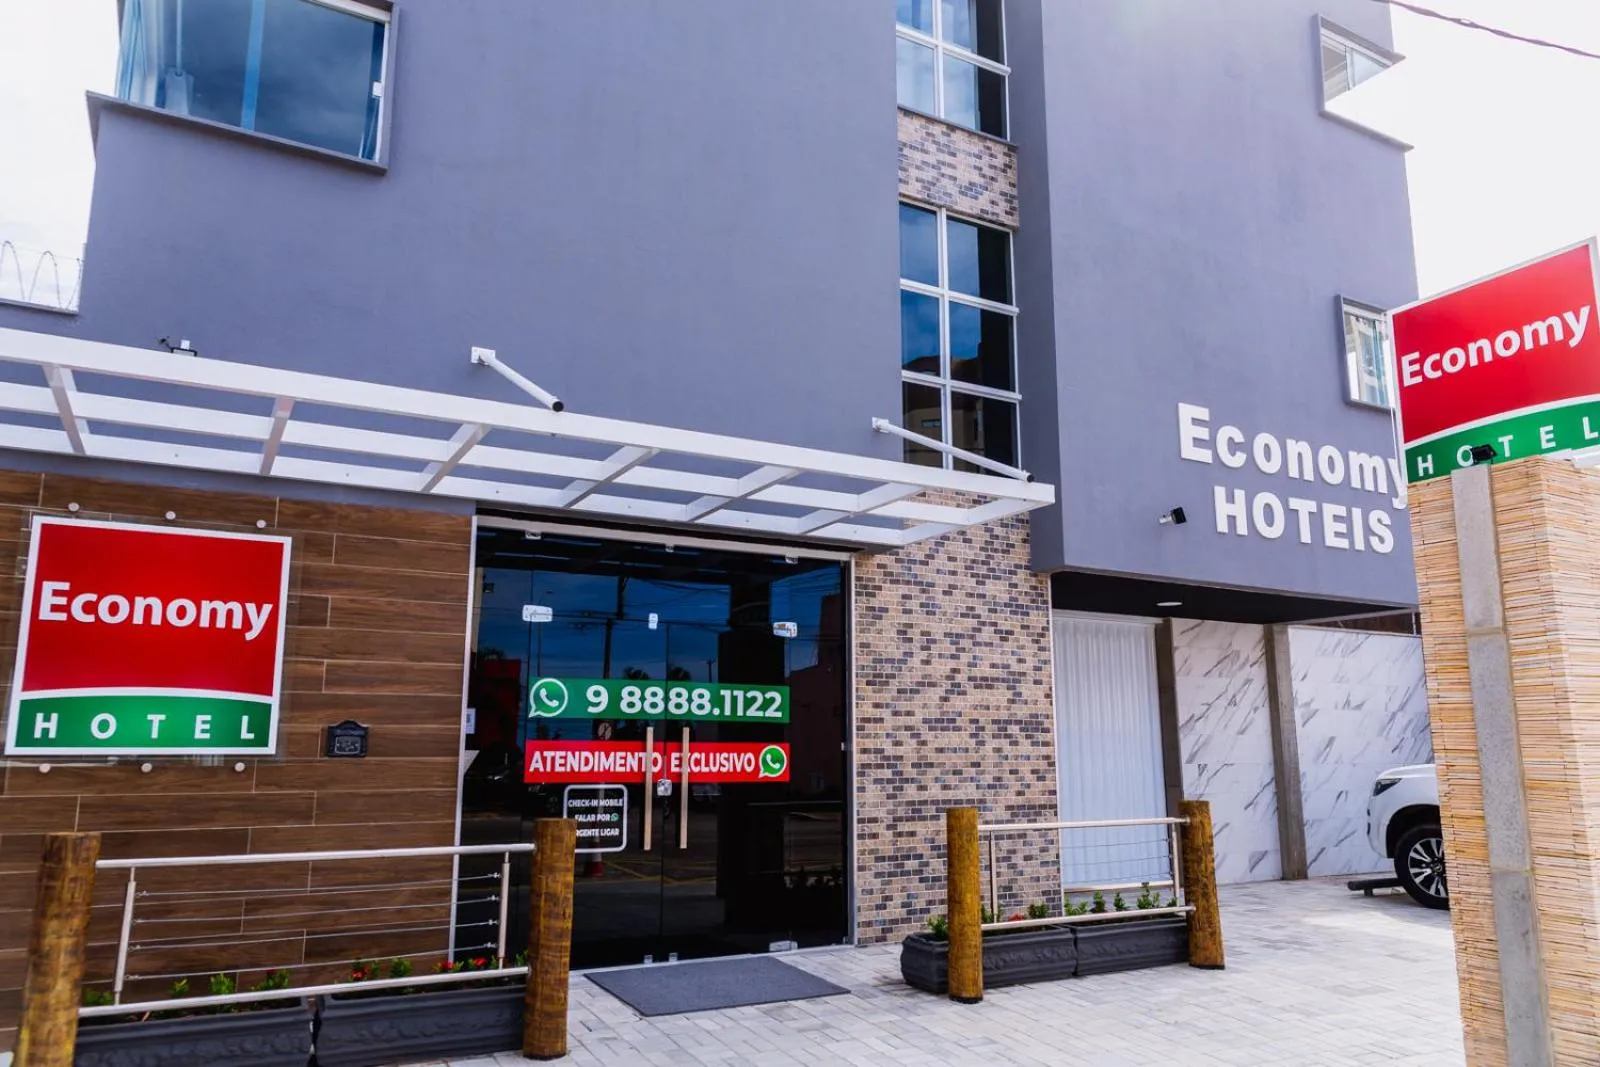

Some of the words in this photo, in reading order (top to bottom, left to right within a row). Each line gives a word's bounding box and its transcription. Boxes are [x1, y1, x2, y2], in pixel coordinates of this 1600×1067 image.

[1402, 305, 1591, 387] Economy
[1417, 416, 1599, 477] HOTEL
[1213, 486, 1394, 554] HOTEIS
[38, 580, 273, 641] Economy
[586, 684, 609, 714] 9
[619, 685, 783, 718] 8888.1122
[33, 712, 255, 740] HOTEL
[529, 750, 662, 773] ATENDIMENTO
[670, 752, 756, 773] ECLUSIVO
[568, 799, 598, 807] CHECK-IN
[600, 799, 623, 807] MOBILE
[575, 814, 595, 822] FALAR
[600, 828, 619, 836] LIGAR
